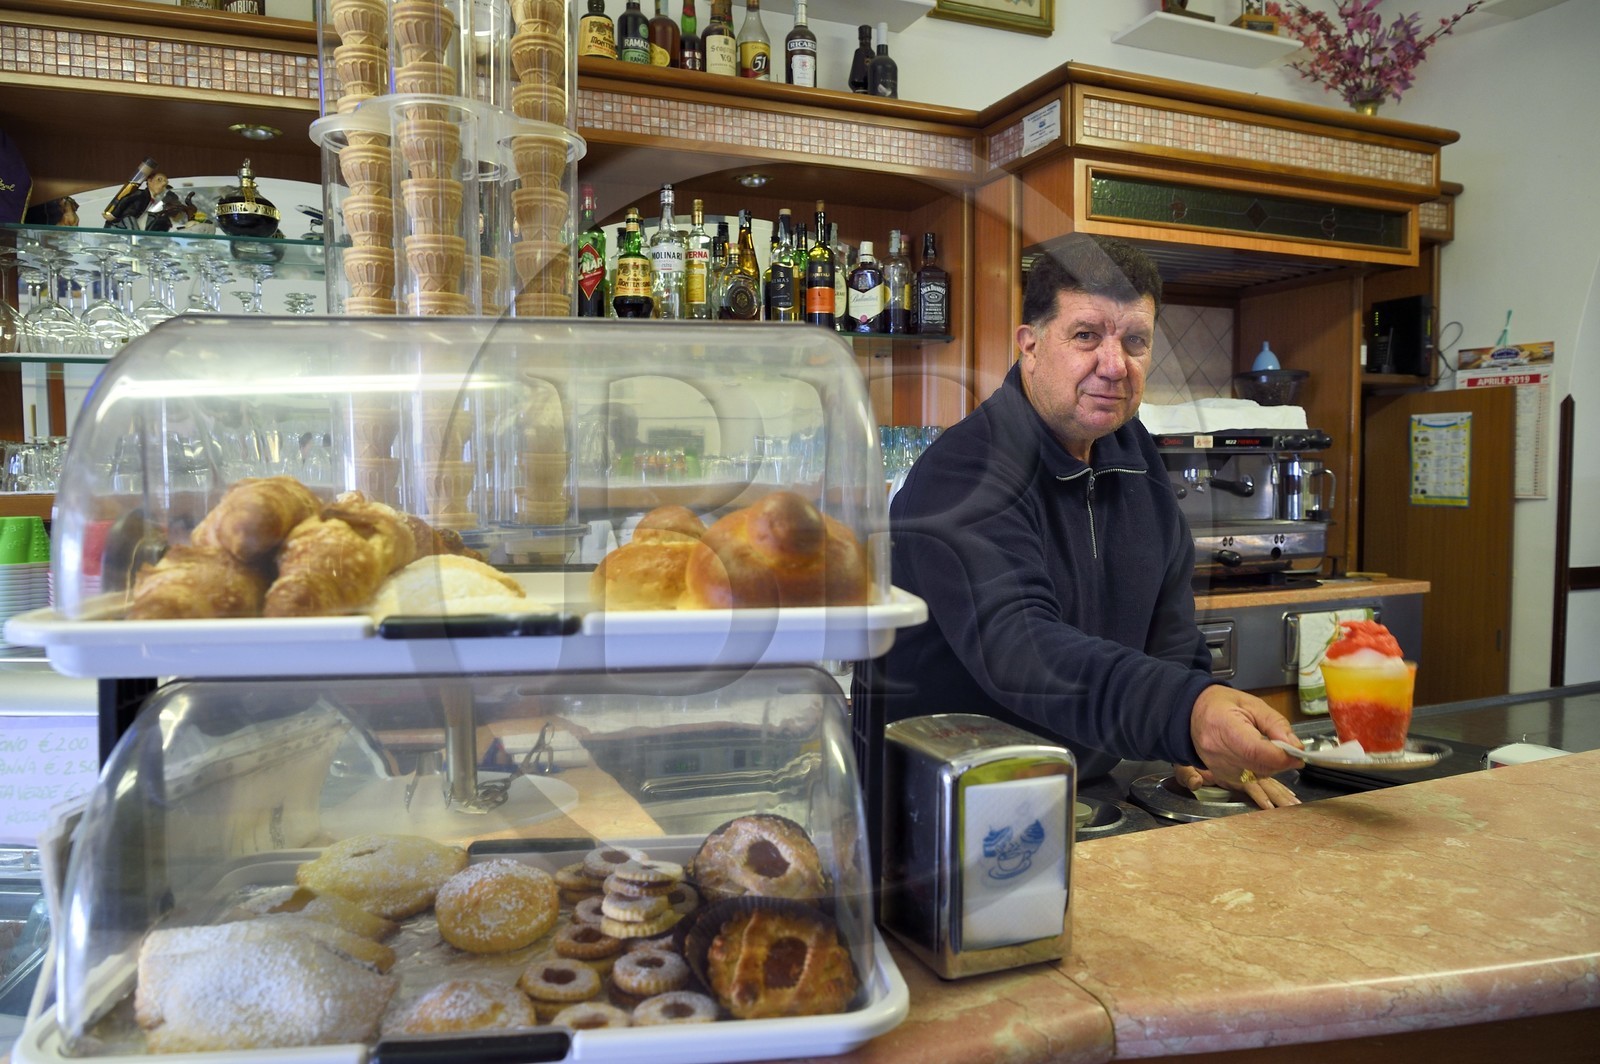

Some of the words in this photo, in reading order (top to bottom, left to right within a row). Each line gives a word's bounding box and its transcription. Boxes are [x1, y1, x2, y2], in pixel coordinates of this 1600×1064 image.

[624, 38, 650, 49] RAMAZ
[752, 55, 767, 72] 51
[651, 250, 683, 260] MOLINARI
[1477, 377, 1507, 386] APRILE
[1508, 376, 1531, 384] 2019
